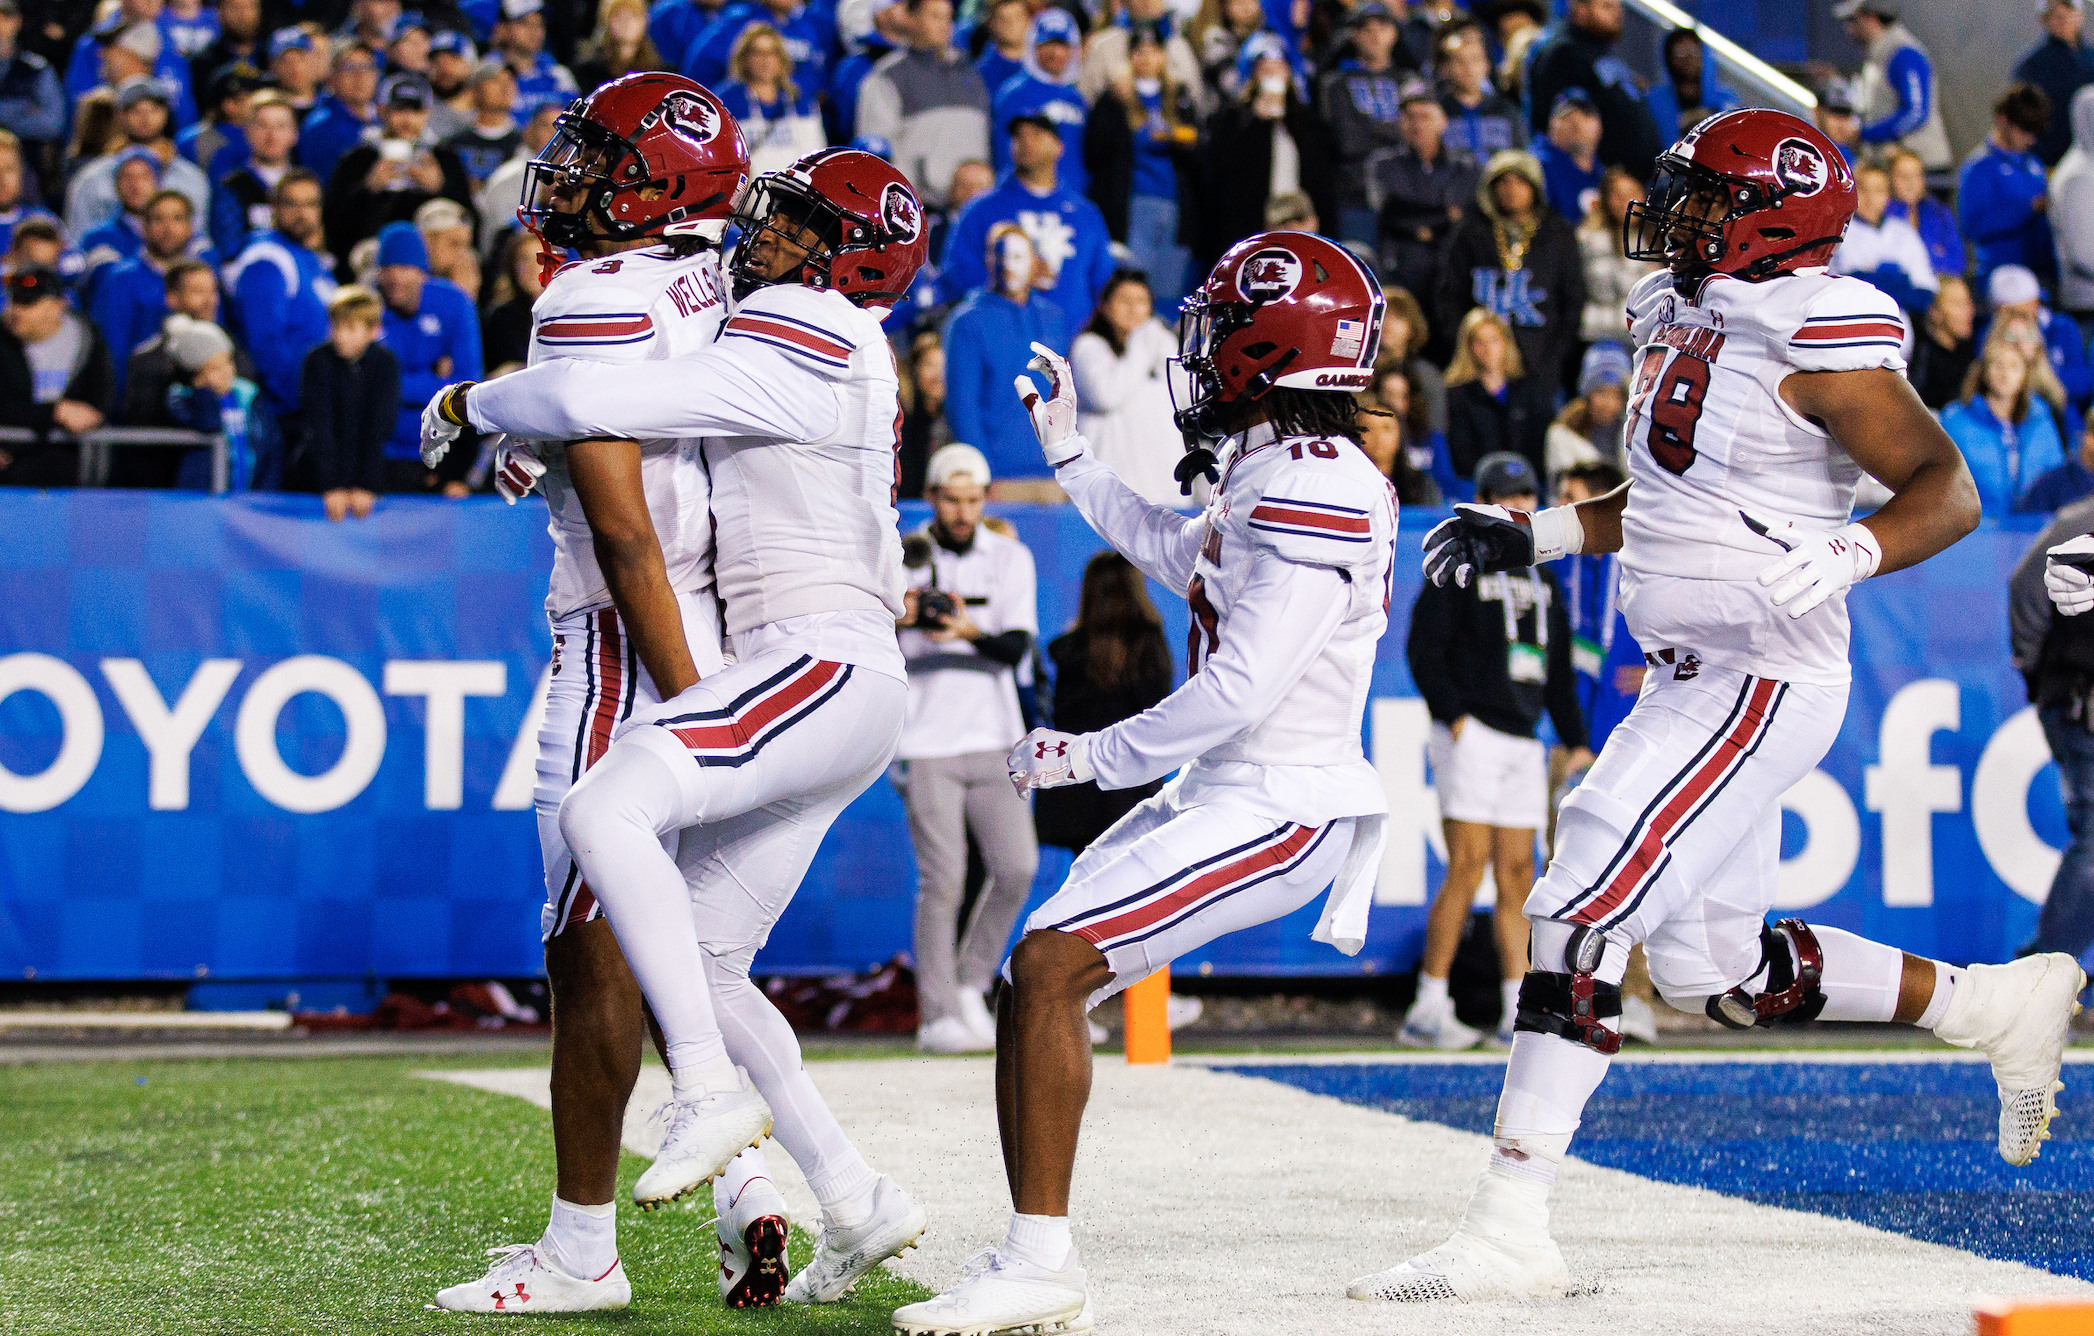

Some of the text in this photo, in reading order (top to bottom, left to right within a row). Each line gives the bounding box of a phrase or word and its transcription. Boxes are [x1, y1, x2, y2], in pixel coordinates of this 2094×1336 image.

[591, 259, 624, 275] 3
[665, 266, 722, 319] WELLS
[1286, 440, 1340, 461] 10
[0, 652, 549, 813] OYOT
